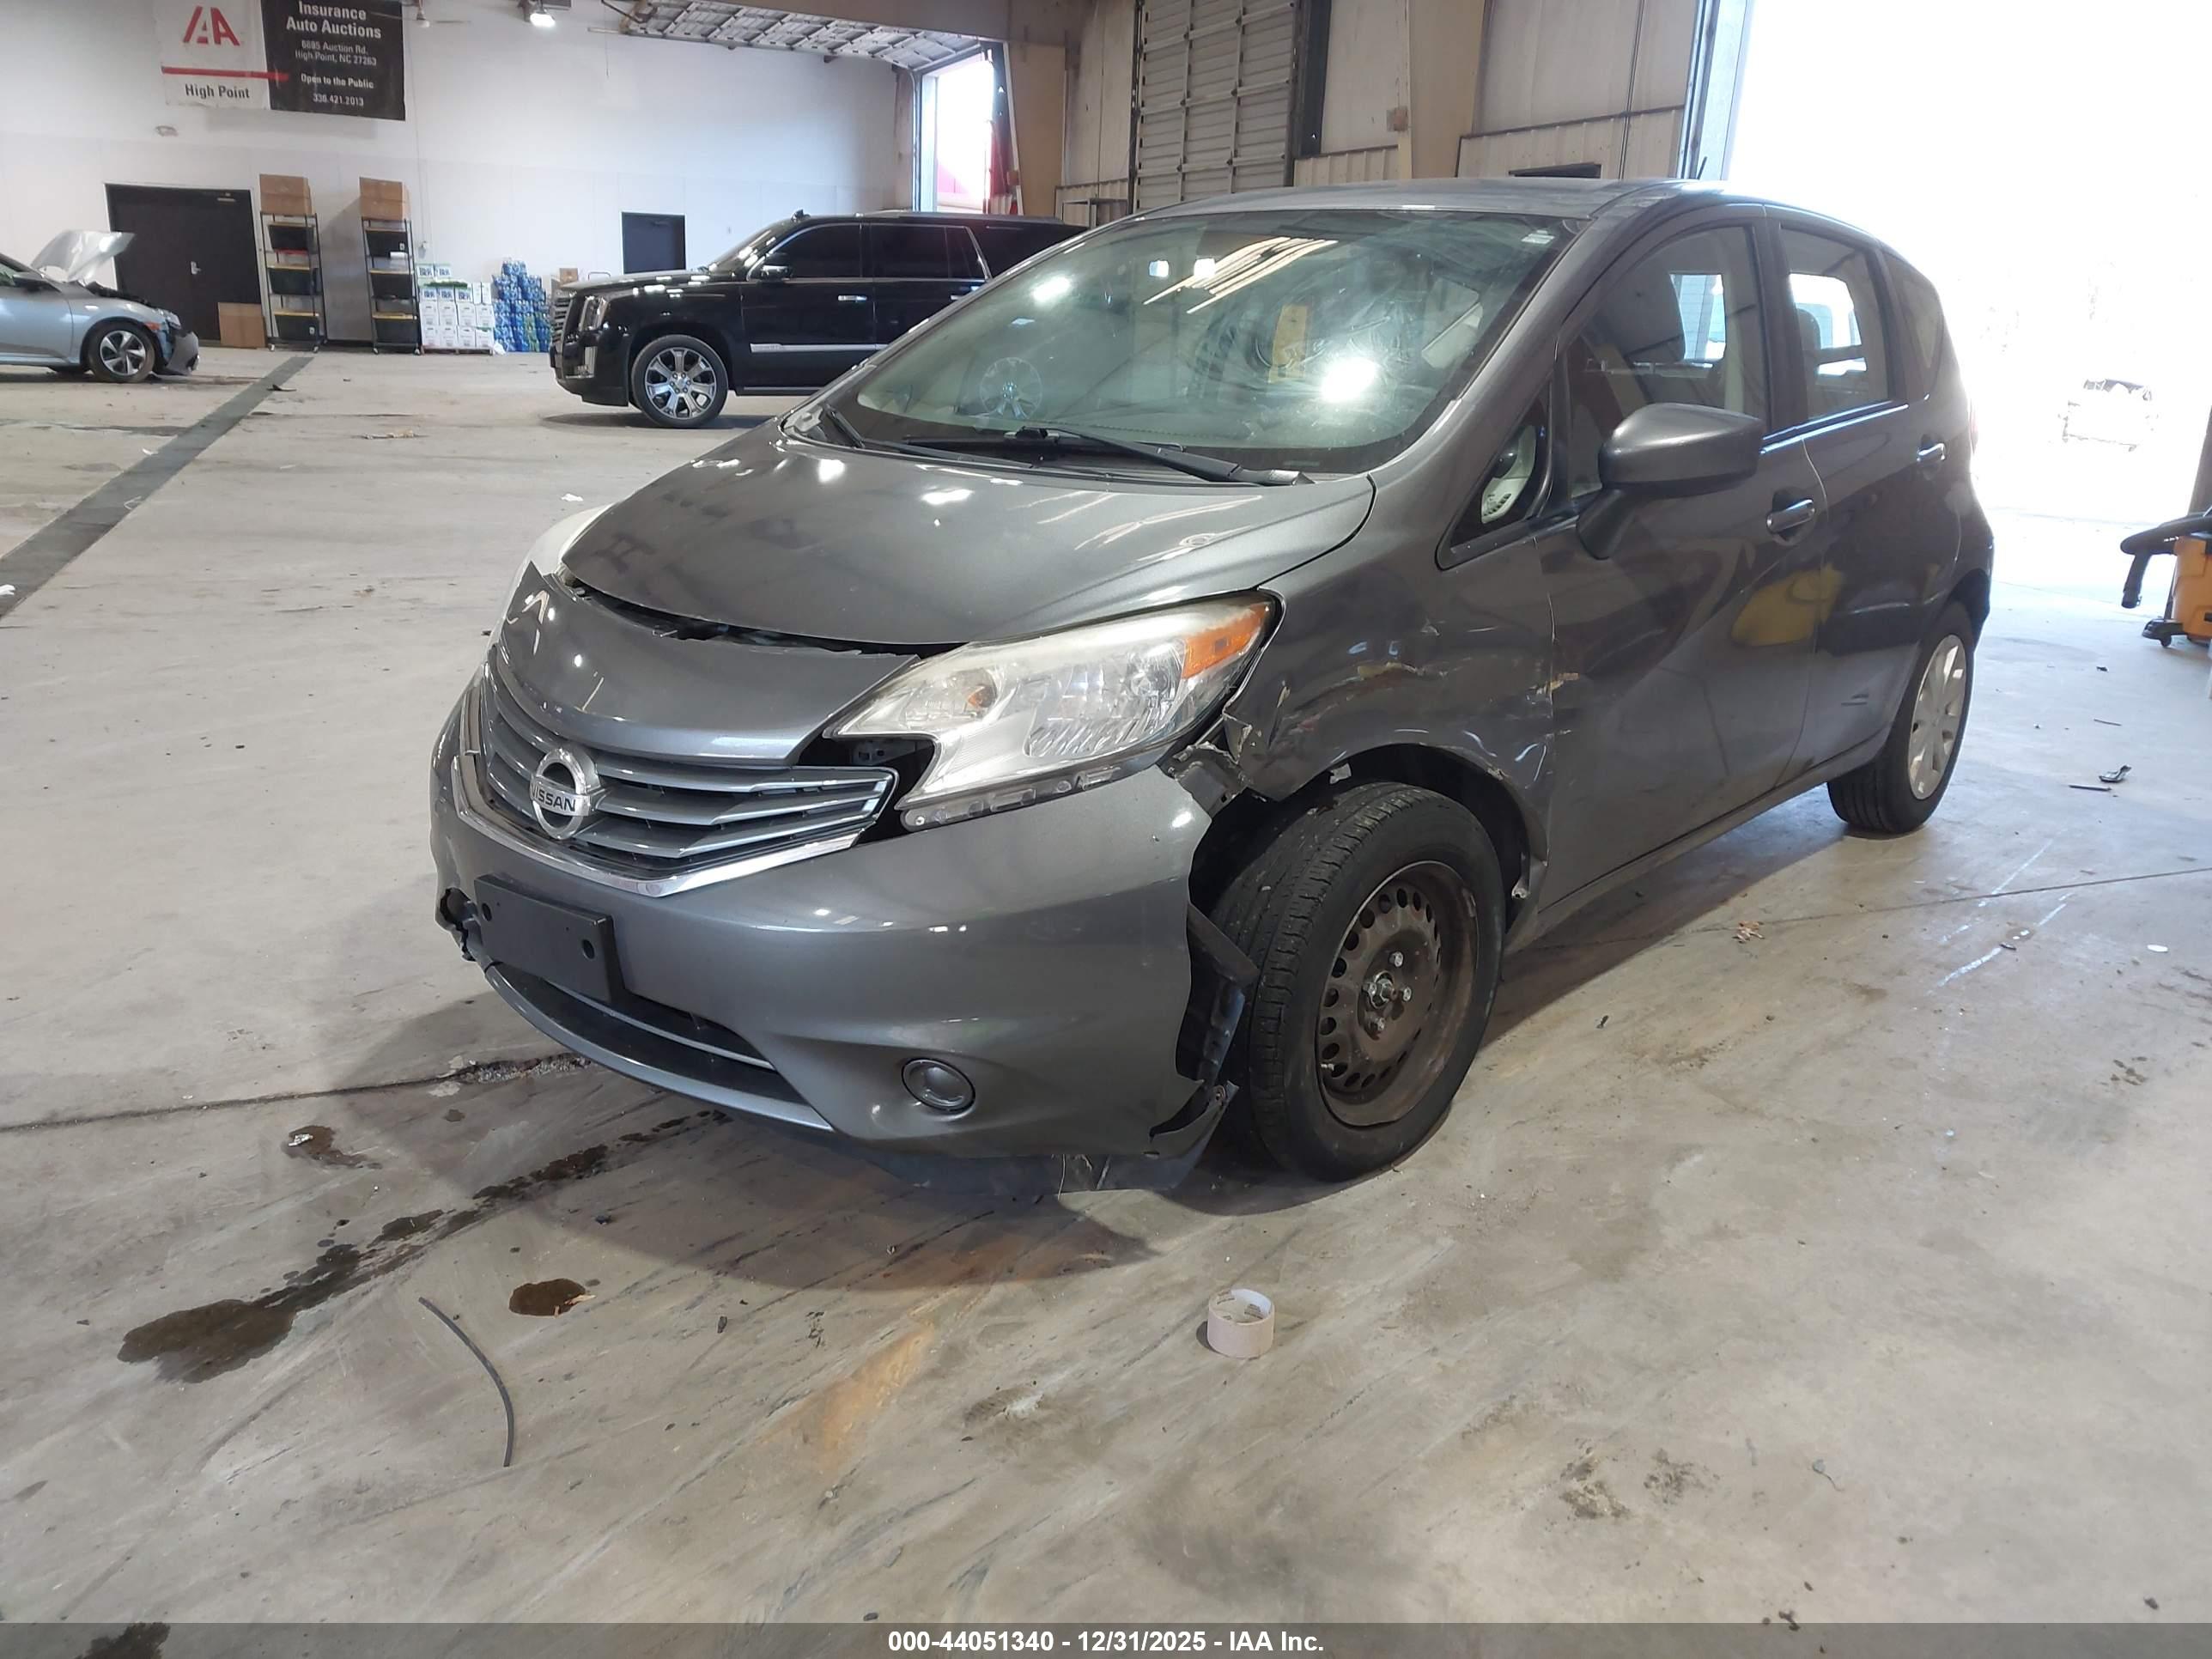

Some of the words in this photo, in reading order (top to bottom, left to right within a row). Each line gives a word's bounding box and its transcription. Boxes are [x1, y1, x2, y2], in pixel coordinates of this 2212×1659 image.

[298, 0, 367, 21] Insurance
[286, 16, 318, 33] Auto
[321, 20, 382, 39] Auctions
[322, 41, 354, 53] Auction
[295, 49, 313, 62] High
[339, 53, 351, 64] NC
[301, 73, 322, 84] Open
[323, 76, 331, 85] to
[333, 76, 346, 86] the
[348, 77, 374, 89] Public
[185, 83, 215, 99] High
[218, 84, 250, 99] Point
[530, 782, 576, 812] NISSAN
